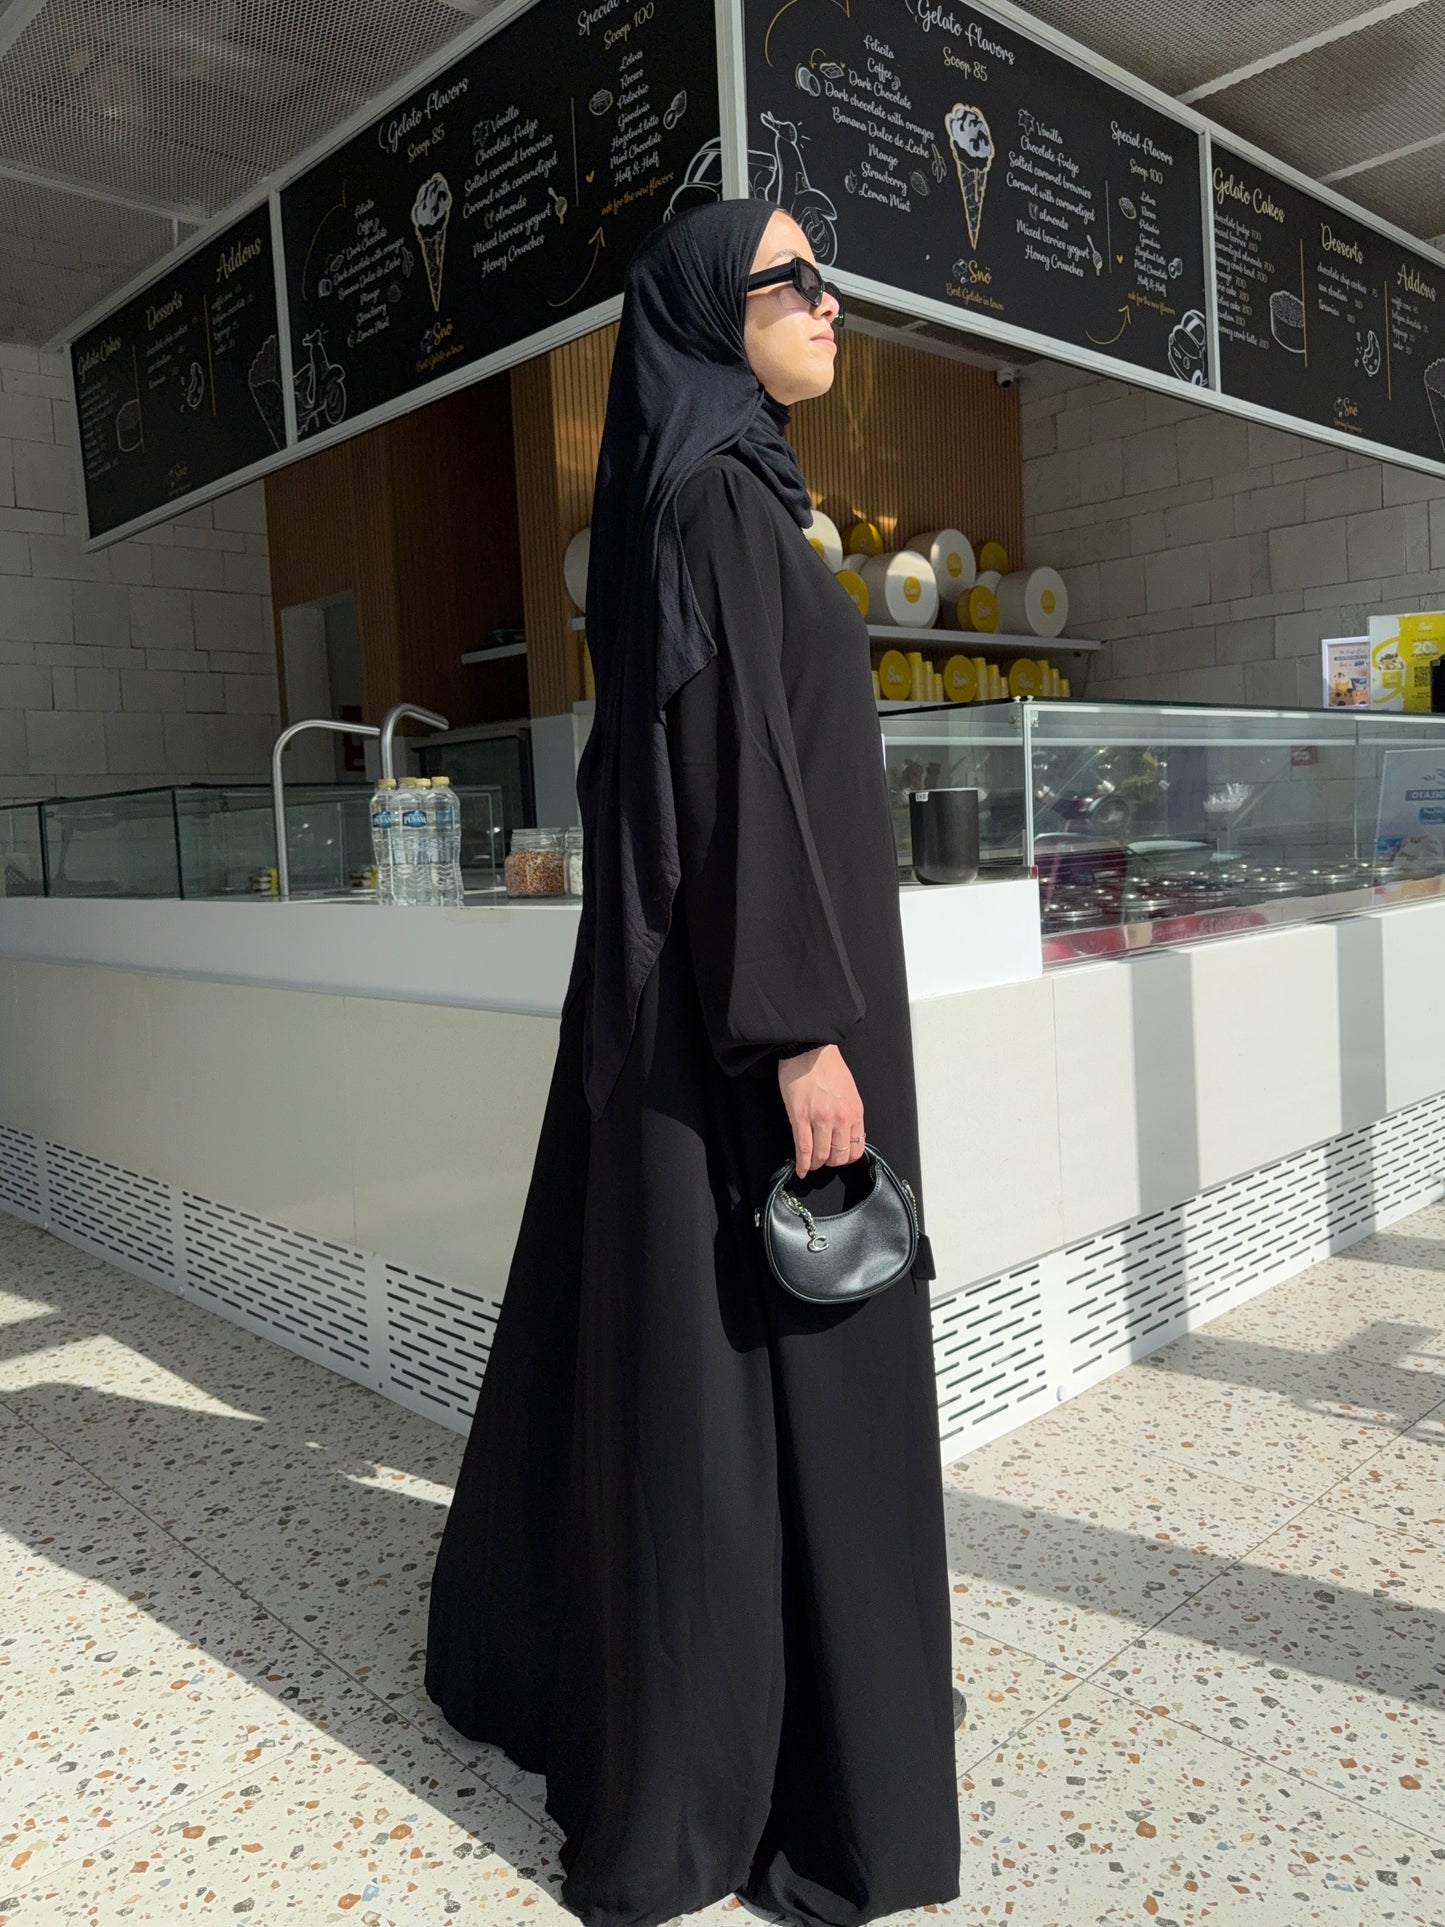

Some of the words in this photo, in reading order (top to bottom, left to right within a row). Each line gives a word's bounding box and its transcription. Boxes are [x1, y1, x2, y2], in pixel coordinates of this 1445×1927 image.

[603, 24, 632, 50] Scoop
[633, 2, 654, 28] 100
[917, 0, 963, 36] Gelato
[867, 57, 894, 83] Coffee
[943, 46, 971, 80] Scoop
[973, 61, 988, 82] 85
[848, 68, 872, 91] Dark
[873, 81, 912, 110] Chocolate
[388, 107, 423, 153] Gelato
[824, 80, 849, 102] Dark
[850, 93, 886, 119] chocolate
[887, 112, 904, 127] with
[905, 121, 935, 144] oranges
[408, 140, 431, 164] Scoop
[432, 123, 445, 145] 85
[832, 106, 867, 131] Banana
[868, 120, 893, 143] Dulce
[894, 133, 904, 148] de
[904, 138, 929, 159] Leche
[1020, 135, 1056, 162] Chocolate
[1036, 121, 1063, 145] Vanilla
[1110, 120, 1141, 149] Special
[868, 143, 899, 171] Mango
[1008, 151, 1033, 174] Salted
[1034, 167, 1062, 186] caramel
[1130, 158, 1149, 182] Scoop
[1149, 168, 1163, 185] 100
[861, 161, 908, 197] Strawberry
[1006, 171, 1039, 197] Caramel
[1039, 188, 1055, 203] with
[1213, 167, 1251, 205] Gelato
[1252, 188, 1286, 223] Cakes
[858, 183, 888, 204] Lemon
[889, 193, 912, 213] Mint
[1016, 219, 1041, 241] Mixed
[1320, 222, 1364, 265] Desserts
[216, 237, 261, 283] Addons
[1024, 244, 1050, 271] Honey
[1397, 263, 1437, 302] Addons
